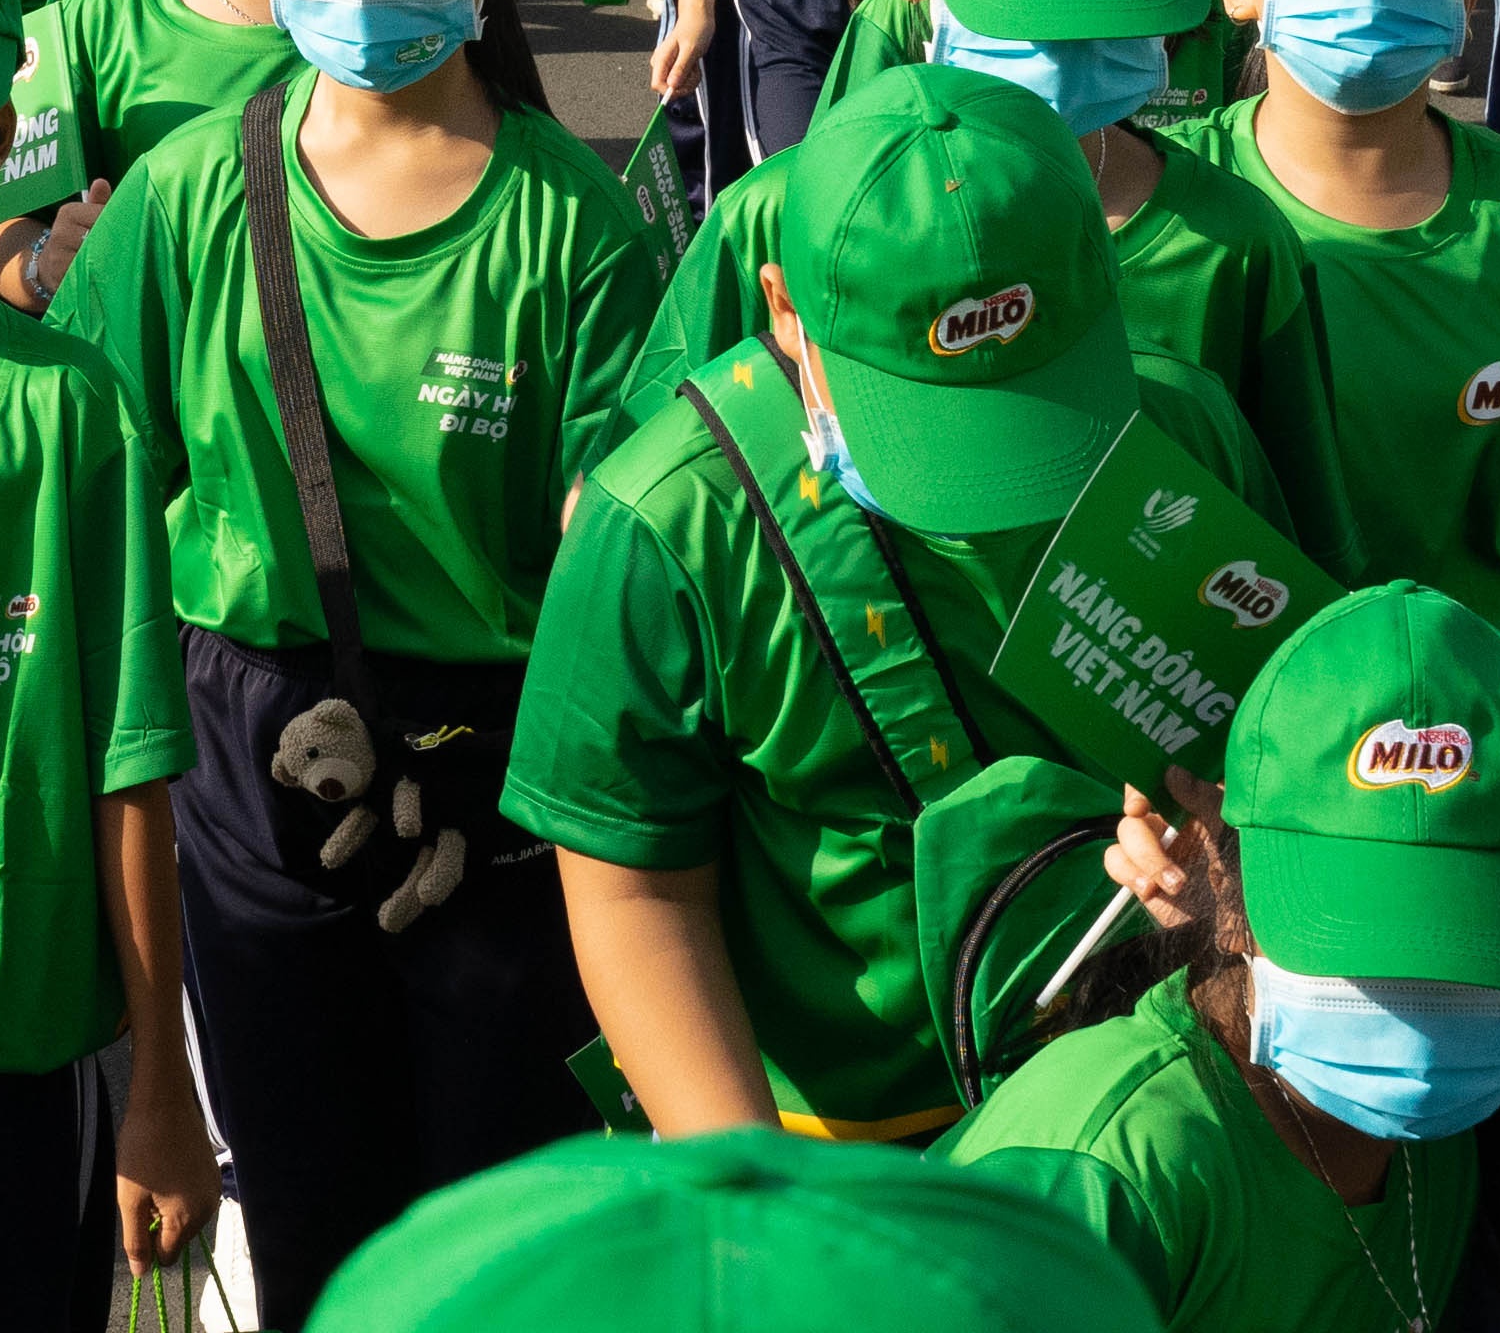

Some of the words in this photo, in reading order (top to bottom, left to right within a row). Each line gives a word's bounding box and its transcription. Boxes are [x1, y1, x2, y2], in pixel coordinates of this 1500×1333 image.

[945, 300, 1028, 351] MILO
[416, 383, 490, 410] NGÀY
[439, 411, 469, 432] ĐI
[472, 413, 509, 442] BỘ
[1209, 575, 1280, 621] MILO
[1048, 563, 1142, 653] NĂNG
[1132, 628, 1237, 723] ĐỘNG
[1049, 622, 1127, 701] VIỆT
[1110, 678, 1204, 757] NAM
[1365, 738, 1466, 776] MILO
